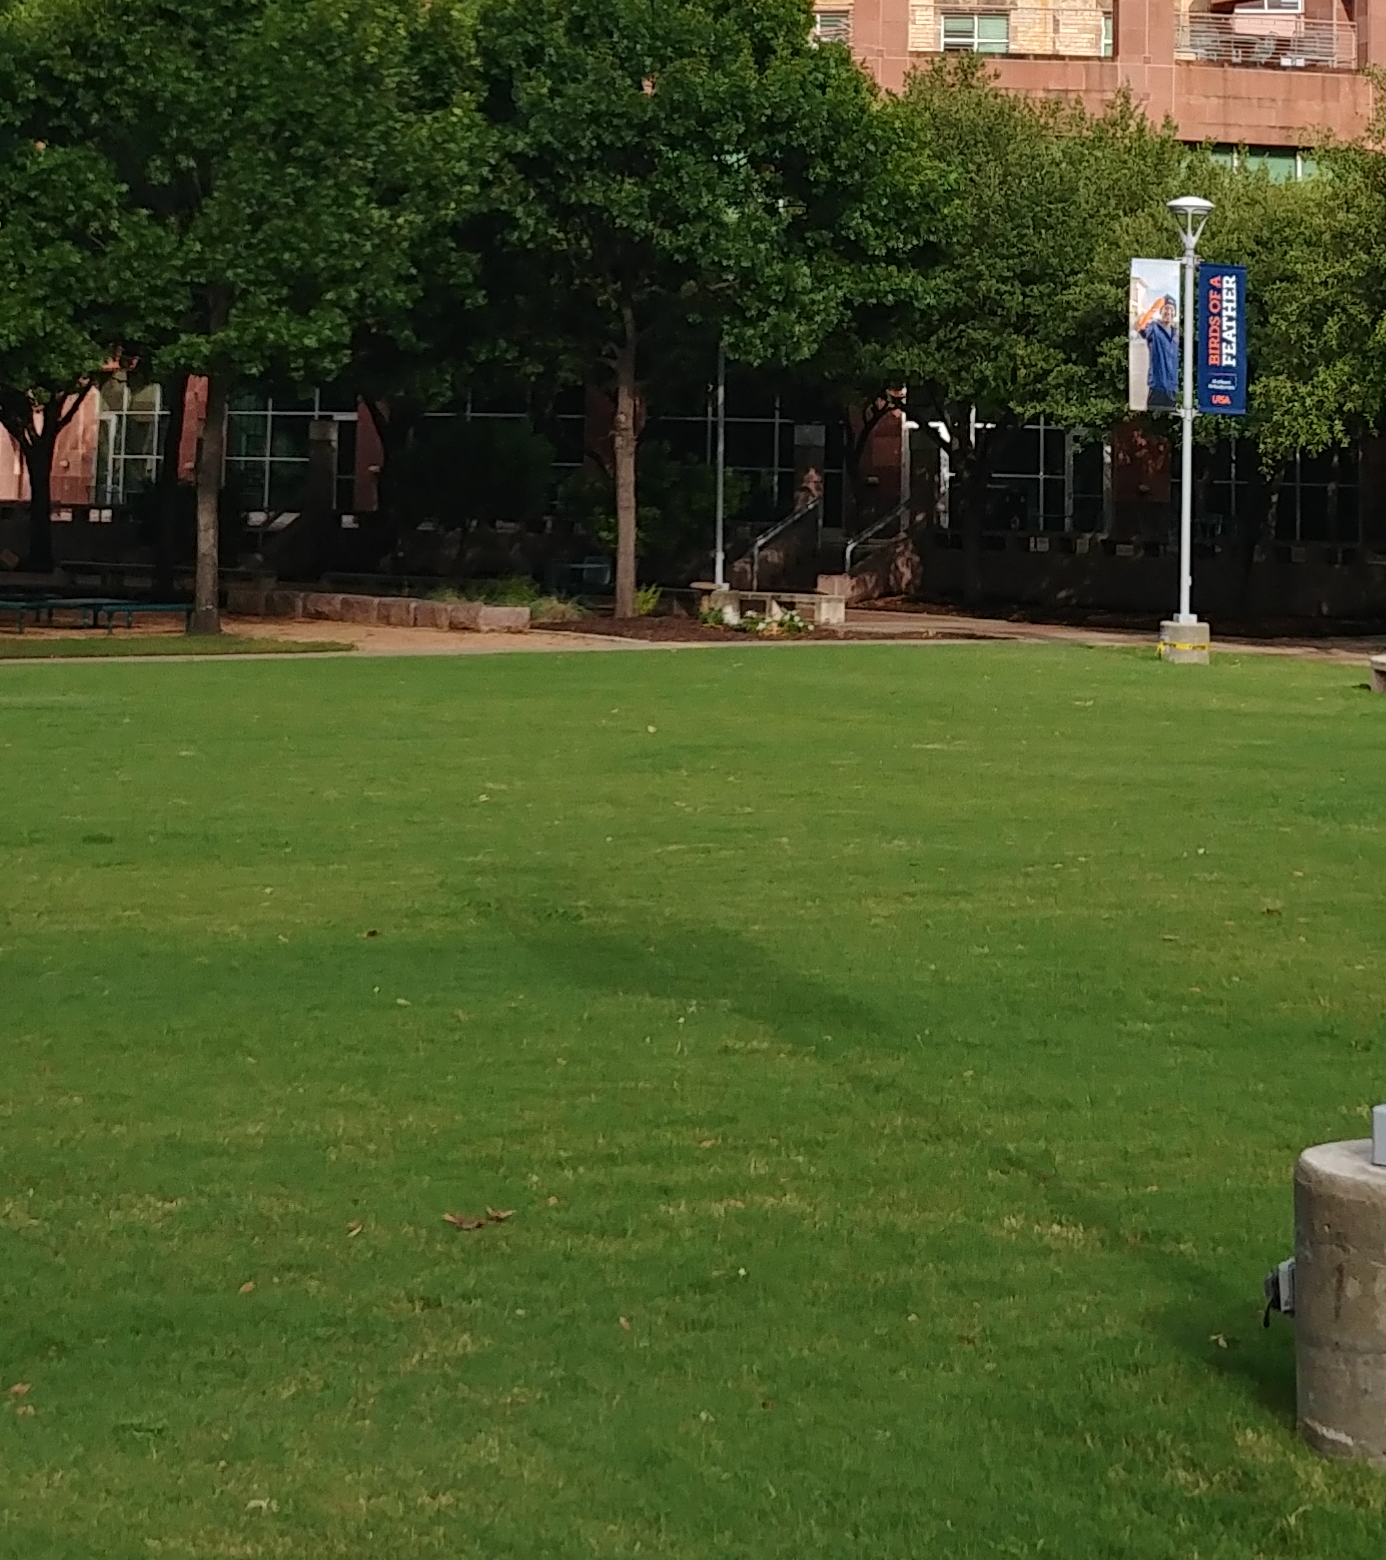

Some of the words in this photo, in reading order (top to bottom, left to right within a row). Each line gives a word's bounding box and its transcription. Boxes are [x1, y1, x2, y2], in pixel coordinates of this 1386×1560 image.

[1209, 274, 1221, 289] A
[1208, 289, 1221, 314] OF
[1221, 274, 1237, 368] FEATHER
[1208, 315, 1221, 366] BIRDS
